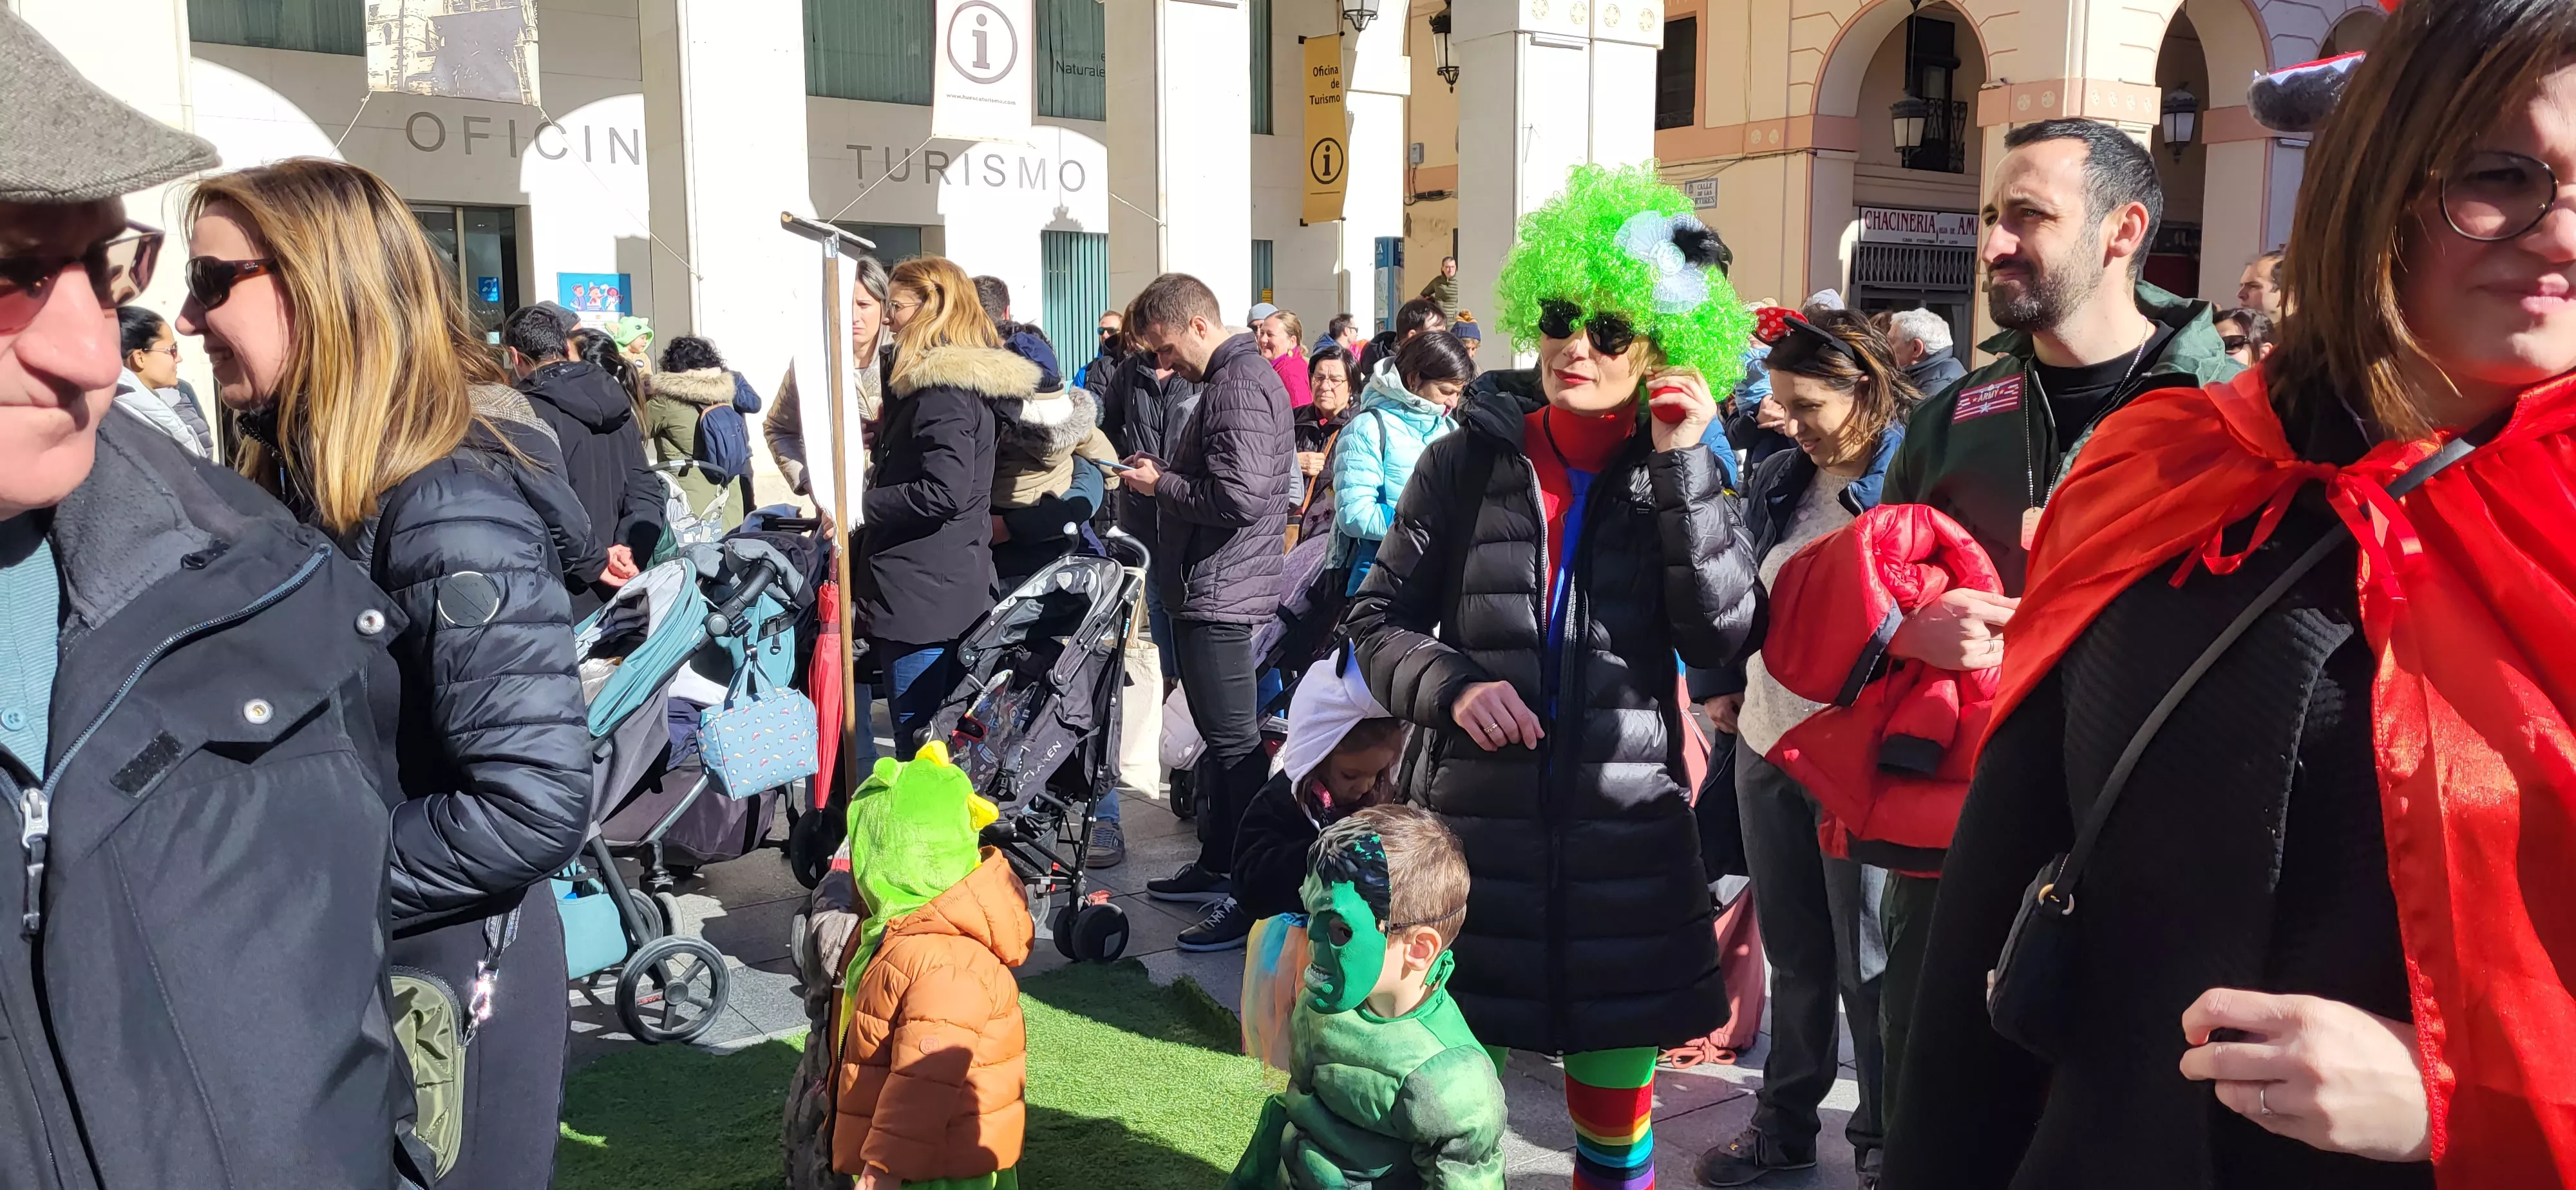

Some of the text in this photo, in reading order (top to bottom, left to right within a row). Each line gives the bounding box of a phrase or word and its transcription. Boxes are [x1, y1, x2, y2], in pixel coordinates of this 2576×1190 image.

[1312, 64, 1339, 77] Oficina
[1331, 77, 1340, 89] de
[946, 93, 1016, 105] www.huescaturismo.com
[1309, 93, 1340, 105] Turismo
[406, 111, 640, 165] OFICIN
[846, 144, 1086, 193] TURISMO
[1864, 210, 1936, 233] CHACINERIA
[1977, 388, 2000, 402] ARMY
